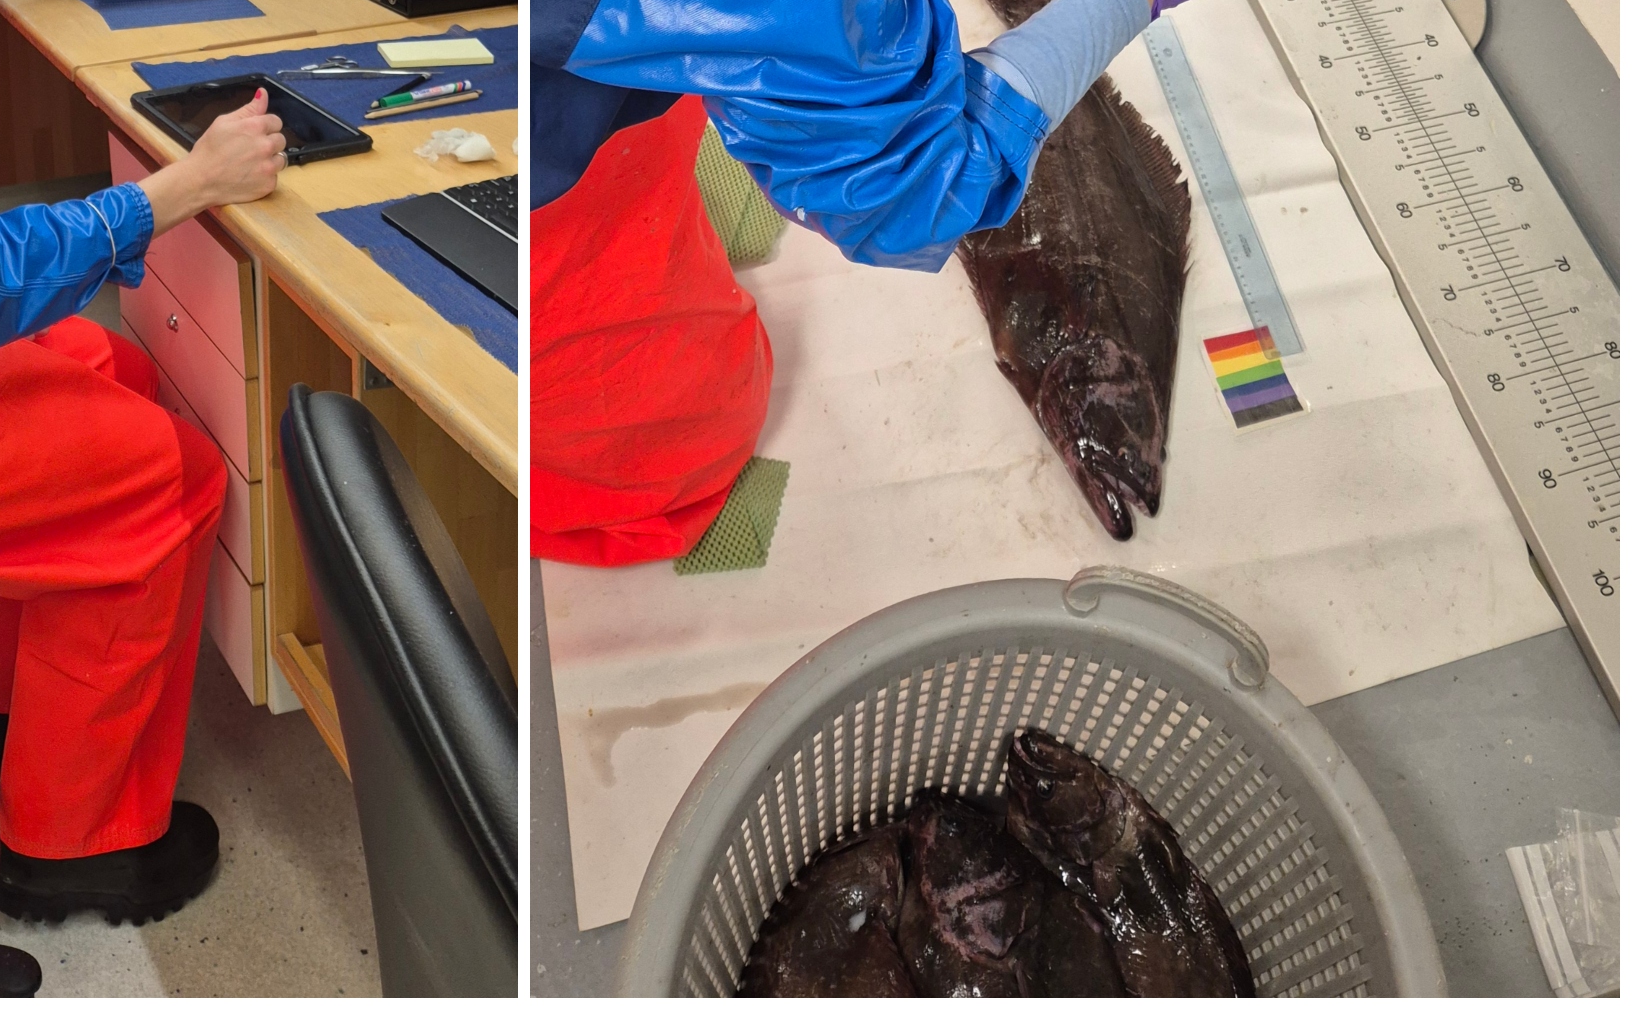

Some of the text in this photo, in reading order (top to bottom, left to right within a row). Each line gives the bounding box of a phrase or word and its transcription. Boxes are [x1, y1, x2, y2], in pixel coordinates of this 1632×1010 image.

[1318, 55, 1333, 69] 40
[1355, 126, 1372, 141] 50
[1424, 34, 1439, 47] 40
[1464, 102, 1480, 118] 50
[1507, 176, 1524, 192] 60
[1554, 255, 1571, 272] 70
[1569, 306, 1580, 314] 5
[1604, 340, 1620, 360] 80
[1396, 202, 1413, 219] 60
[1438, 243, 1448, 251] 5
[1440, 284, 1457, 302] 70
[1484, 328, 1494, 336] 5
[1487, 373, 1506, 392] 80
[1534, 420, 1545, 429] 5
[1538, 468, 1557, 489] 90
[1587, 520, 1599, 529] 5
[1592, 568, 1615, 597] 100
